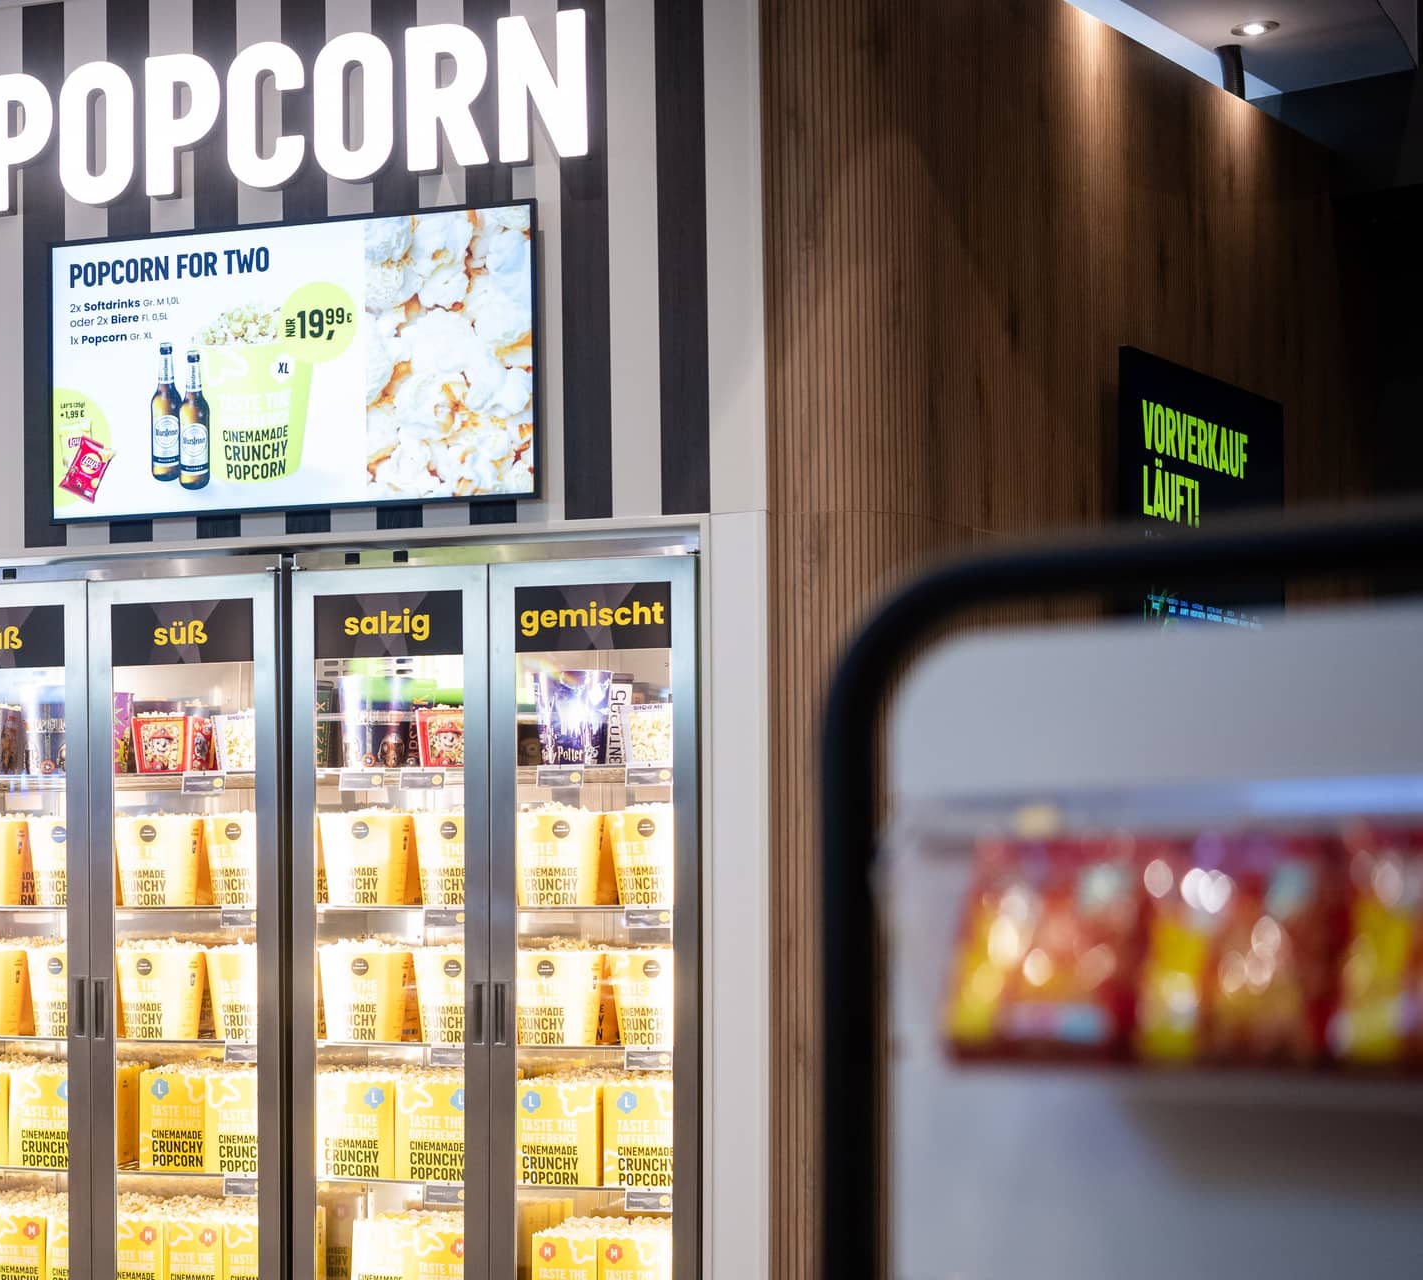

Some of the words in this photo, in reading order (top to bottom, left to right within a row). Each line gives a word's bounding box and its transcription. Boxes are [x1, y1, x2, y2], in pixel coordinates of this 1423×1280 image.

[70, 256, 169, 288] POPCORN
[177, 252, 217, 278] FOR
[224, 247, 269, 274] TWO
[70, 303, 81, 313] 2x
[84, 299, 140, 312] Softdrinks
[143, 299, 154, 307] Gr.
[157, 298, 164, 306] M
[70, 318, 94, 328] oder
[97, 316, 108, 325] 2x
[111, 314, 139, 324] Biere
[285, 319, 295, 337] NUR
[70, 336, 78, 345] 1x
[82, 333, 127, 345] Popcorn
[130, 332, 142, 340] Gr.
[144, 332, 152, 340] XL
[278, 362, 289, 373] XL
[223, 425, 288, 442] CINEMAMADE
[1142, 399, 1248, 479] VORVERKAUF
[225, 440, 288, 461] CRUNCHY
[227, 459, 285, 480] POPCORN
[1143, 458, 1200, 528] LÄUFT!
[344, 608, 430, 641] salzig
[520, 601, 664, 637] gemischt
[154, 620, 208, 646] süß
[558, 746, 583, 762] Potter
[524, 868, 577, 877] CINEMAMADE
[618, 866, 664, 875] CINEMAMAD
[213, 879, 251, 890] CRUNCH
[525, 878, 577, 891] CRUNCHY
[619, 877, 666, 890] CRUNCH
[214, 892, 251, 904] POPCOR
[527, 892, 577, 904] POPCORN
[620, 1008, 666, 1016] CINEMAMA
[223, 1014, 252, 1026] CRUN
[519, 1018, 565, 1030] CRUNCHY
[621, 1018, 664, 1030] CRUNCH
[225, 1028, 251, 1039] POPC
[521, 1032, 564, 1044] POPCORN
[624, 1032, 666, 1045] POPCOR
[158, 1083, 163, 1094] L
[371, 1092, 377, 1103] L
[529, 1095, 534, 1107] L
[624, 1096, 631, 1108] L
[151, 1105, 180, 1116] TASTE
[184, 1105, 202, 1117] THE
[521, 1119, 553, 1131] TASTE
[558, 1119, 577, 1132] THE
[151, 1130, 202, 1139] CINEMAMADE
[218, 1135, 258, 1144] CINEMAM
[152, 1140, 203, 1153] CRUNCHY
[219, 1146, 257, 1158] CRUNC
[410, 1141, 465, 1152] CINEMAMADE
[522, 1145, 577, 1156] CINEMAMADE
[618, 1146, 673, 1157] CINEMAMADE
[153, 1154, 203, 1167] POPCORN
[325, 1149, 379, 1163] CRUNCHY
[410, 1152, 465, 1167] CRUNCHY
[220, 1160, 256, 1172] POPCO
[522, 1156, 578, 1170] CRUNCHY
[326, 1163, 379, 1177] POPCORN
[410, 1167, 465, 1181] POPCORN
[523, 1171, 578, 1185] POPCORN
[28, 1226, 35, 1235] M
[145, 1231, 152, 1240] M
[205, 1232, 212, 1242] M
[456, 1243, 464, 1253] M
[544, 1247, 551, 1256] M
[611, 1249, 618, 1258] M
[117, 1272, 155, 1280] NEMAMADE
[539, 1268, 568, 1280] TASTE
[569, 1268, 589, 1280] THE
